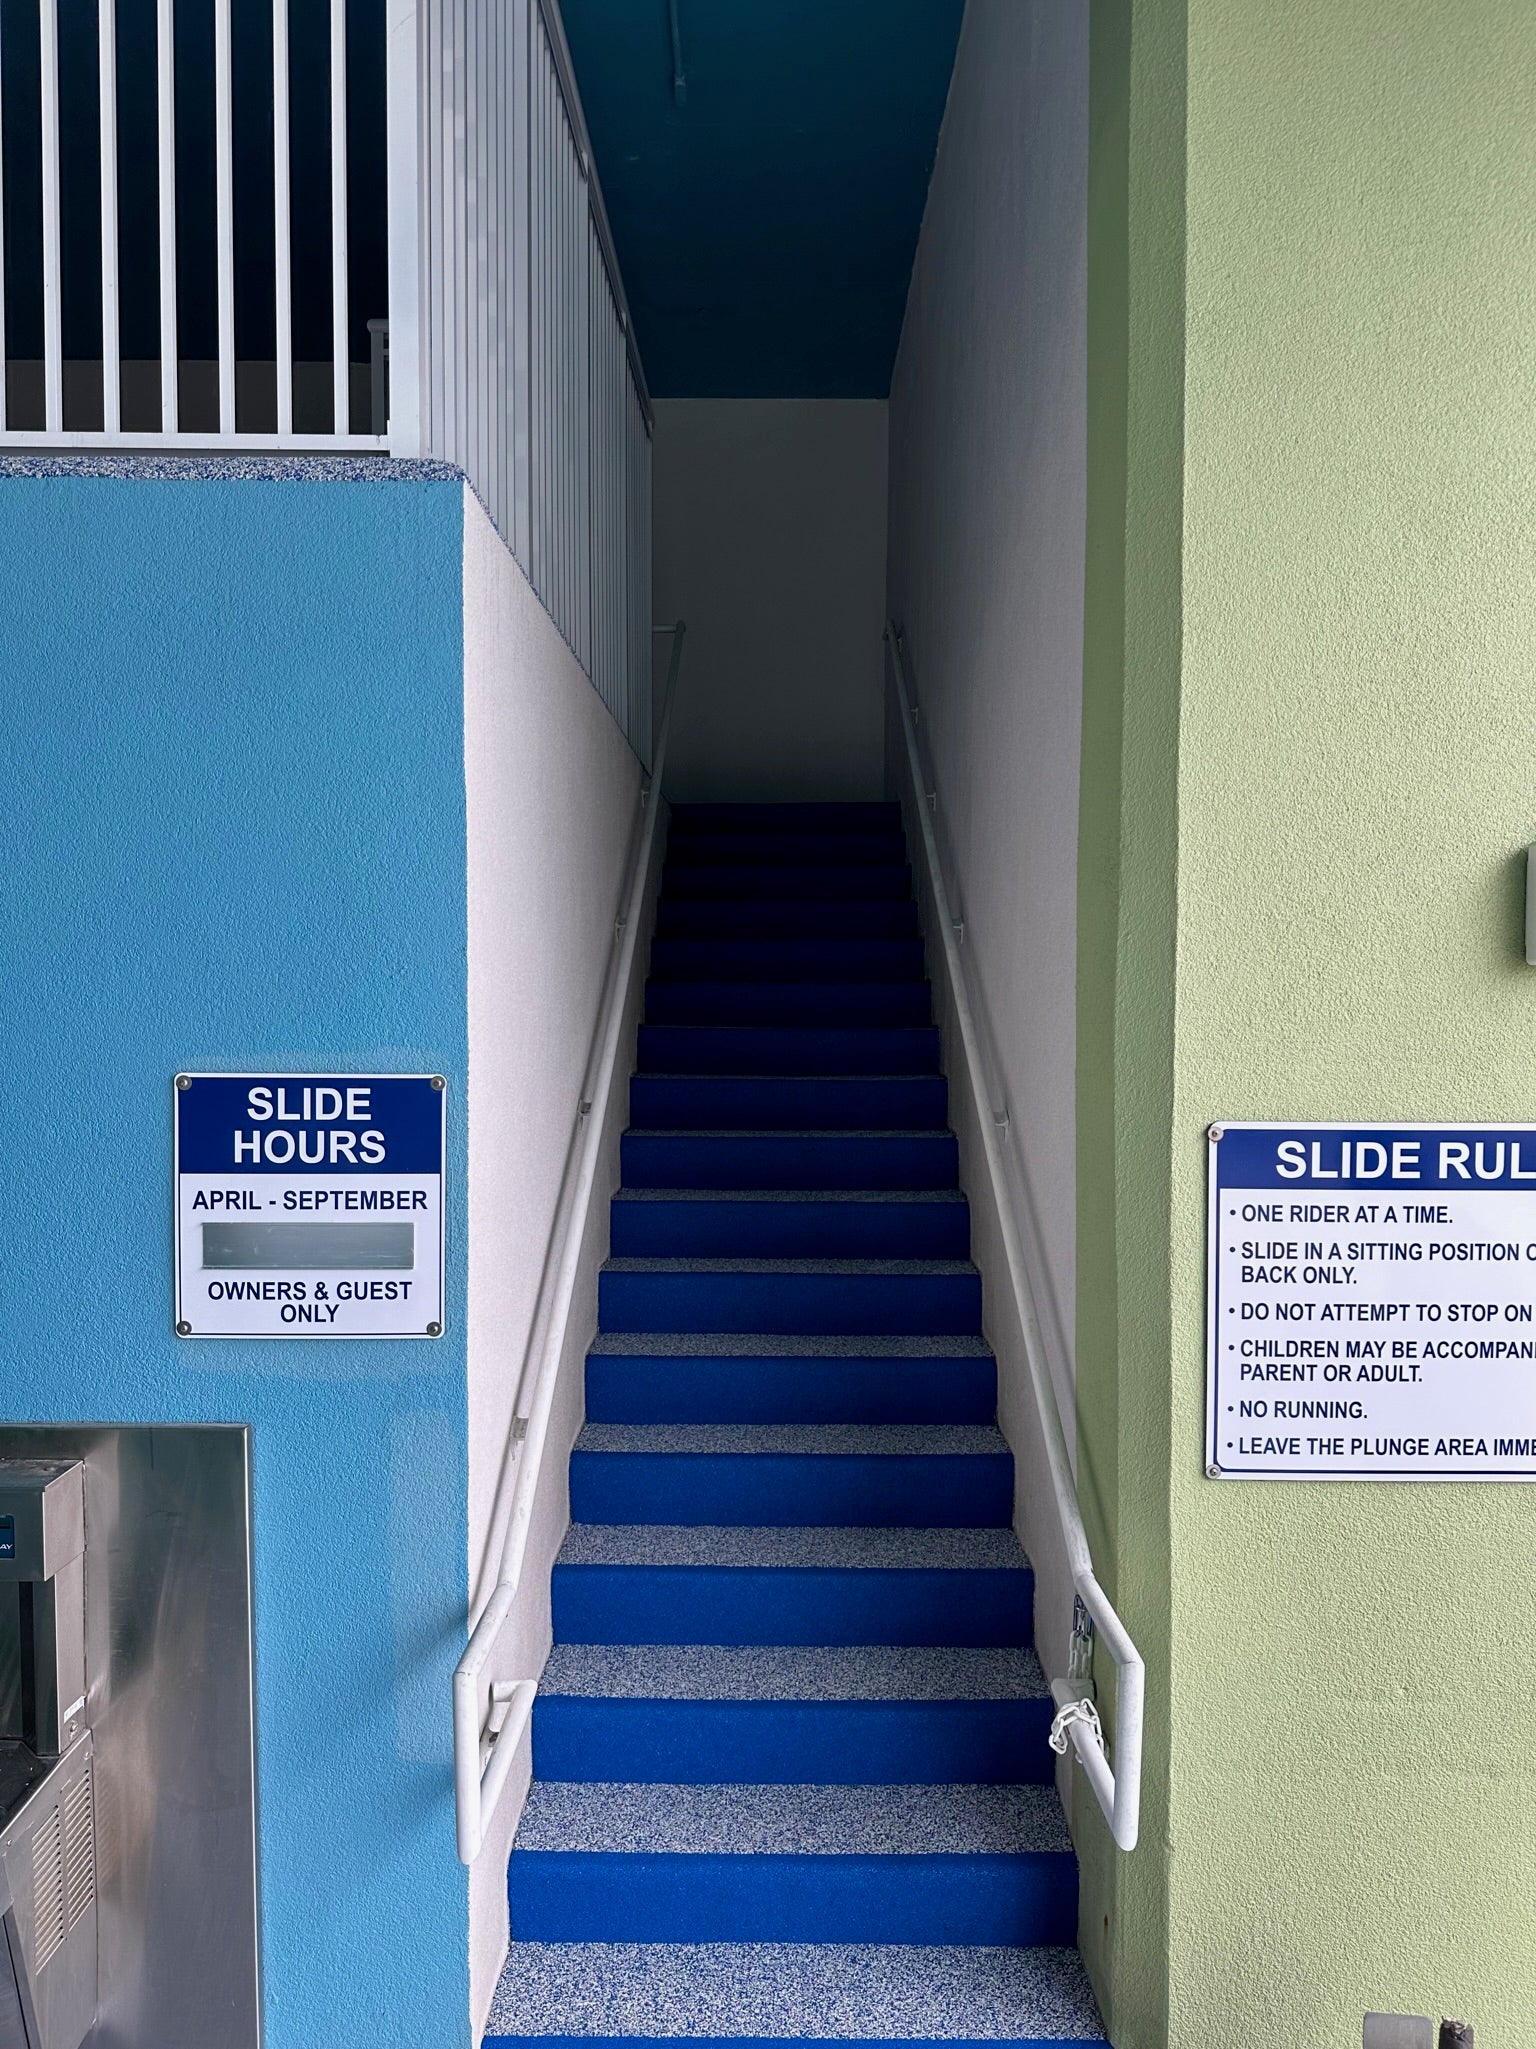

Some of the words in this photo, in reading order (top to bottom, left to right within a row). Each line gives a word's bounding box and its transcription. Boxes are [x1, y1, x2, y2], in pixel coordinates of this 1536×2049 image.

[247, 1087, 372, 1121] SLIDE
[234, 1130, 386, 1163] HOURS
[1276, 1141, 1421, 1179] SLIDE
[192, 1191, 262, 1210] APRIL
[283, 1190, 428, 1210] SEPTEMBER
[1242, 1204, 1283, 1223] ONE
[1290, 1205, 1350, 1223] RIDER
[1355, 1205, 1379, 1223] AT
[1384, 1205, 1398, 1223] A
[1403, 1205, 1453, 1224] TIME.
[1241, 1242, 1298, 1260] SLIDE
[1304, 1242, 1323, 1260] IN
[1328, 1242, 1342, 1260] A
[1347, 1242, 1423, 1261] SITTING
[1429, 1243, 1519, 1261] POSITION
[1241, 1265, 1297, 1284] BACK
[1303, 1266, 1357, 1285] ONLY.
[207, 1281, 307, 1300] OWNERS
[314, 1281, 329, 1300] &
[336, 1281, 412, 1300] GUEST
[280, 1304, 340, 1323] ONLY
[1241, 1302, 1269, 1321] DO
[1275, 1303, 1316, 1321] NOT
[1320, 1304, 1410, 1322] ATTEMPT
[1416, 1304, 1441, 1322] TO
[1448, 1304, 1499, 1322] STOP
[1505, 1304, 1532, 1323] ON
[1240, 1340, 1339, 1359] CHILDREN
[1346, 1341, 1386, 1359] MAY
[1392, 1341, 1418, 1359] BE
[1240, 1364, 1318, 1382] PARENT
[1323, 1364, 1351, 1382] OR
[1356, 1364, 1423, 1383] ADULT.
[1239, 1400, 1267, 1418] NO
[1274, 1401, 1368, 1419] RUNNING.
[1239, 1437, 1301, 1455] LEAVE
[1307, 1438, 1345, 1455] THE
[1351, 1438, 1429, 1456] PLUNGE
[1434, 1438, 1488, 1456] AREA
